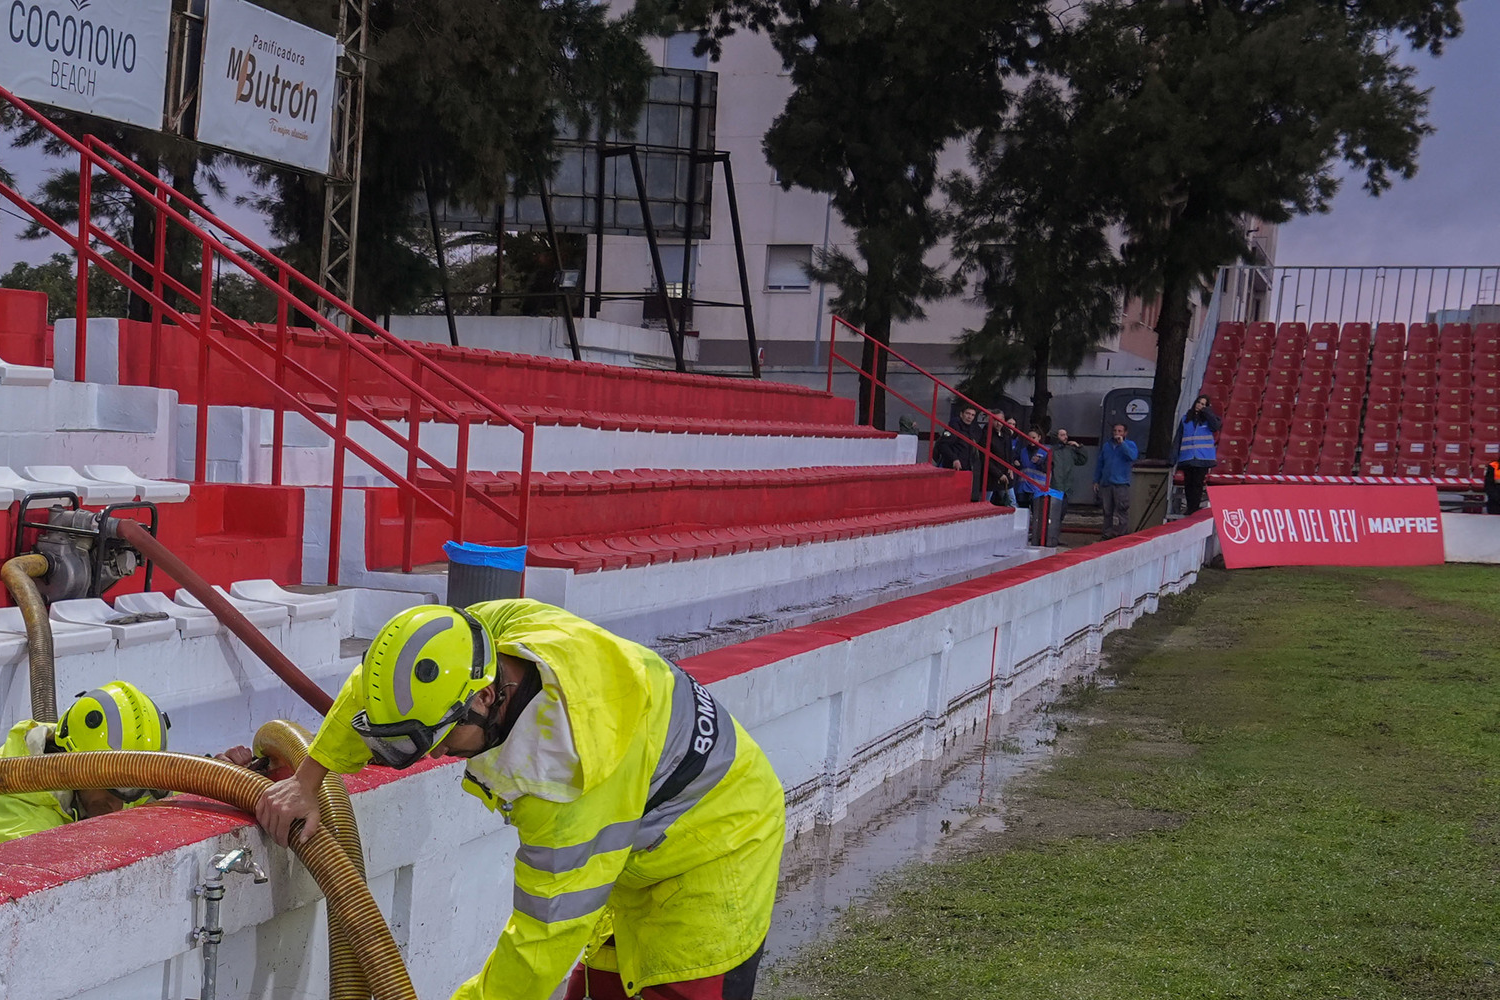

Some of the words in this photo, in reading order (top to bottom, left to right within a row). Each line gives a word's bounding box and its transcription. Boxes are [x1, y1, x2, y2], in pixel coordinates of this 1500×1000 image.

[252, 34, 305, 66] Panificadora
[51, 59, 97, 96] BEACH
[1250, 509, 1299, 543] COPA
[1297, 509, 1329, 543] DEL
[1329, 509, 1359, 543] REY
[1368, 517, 1439, 533] MAPFRE
